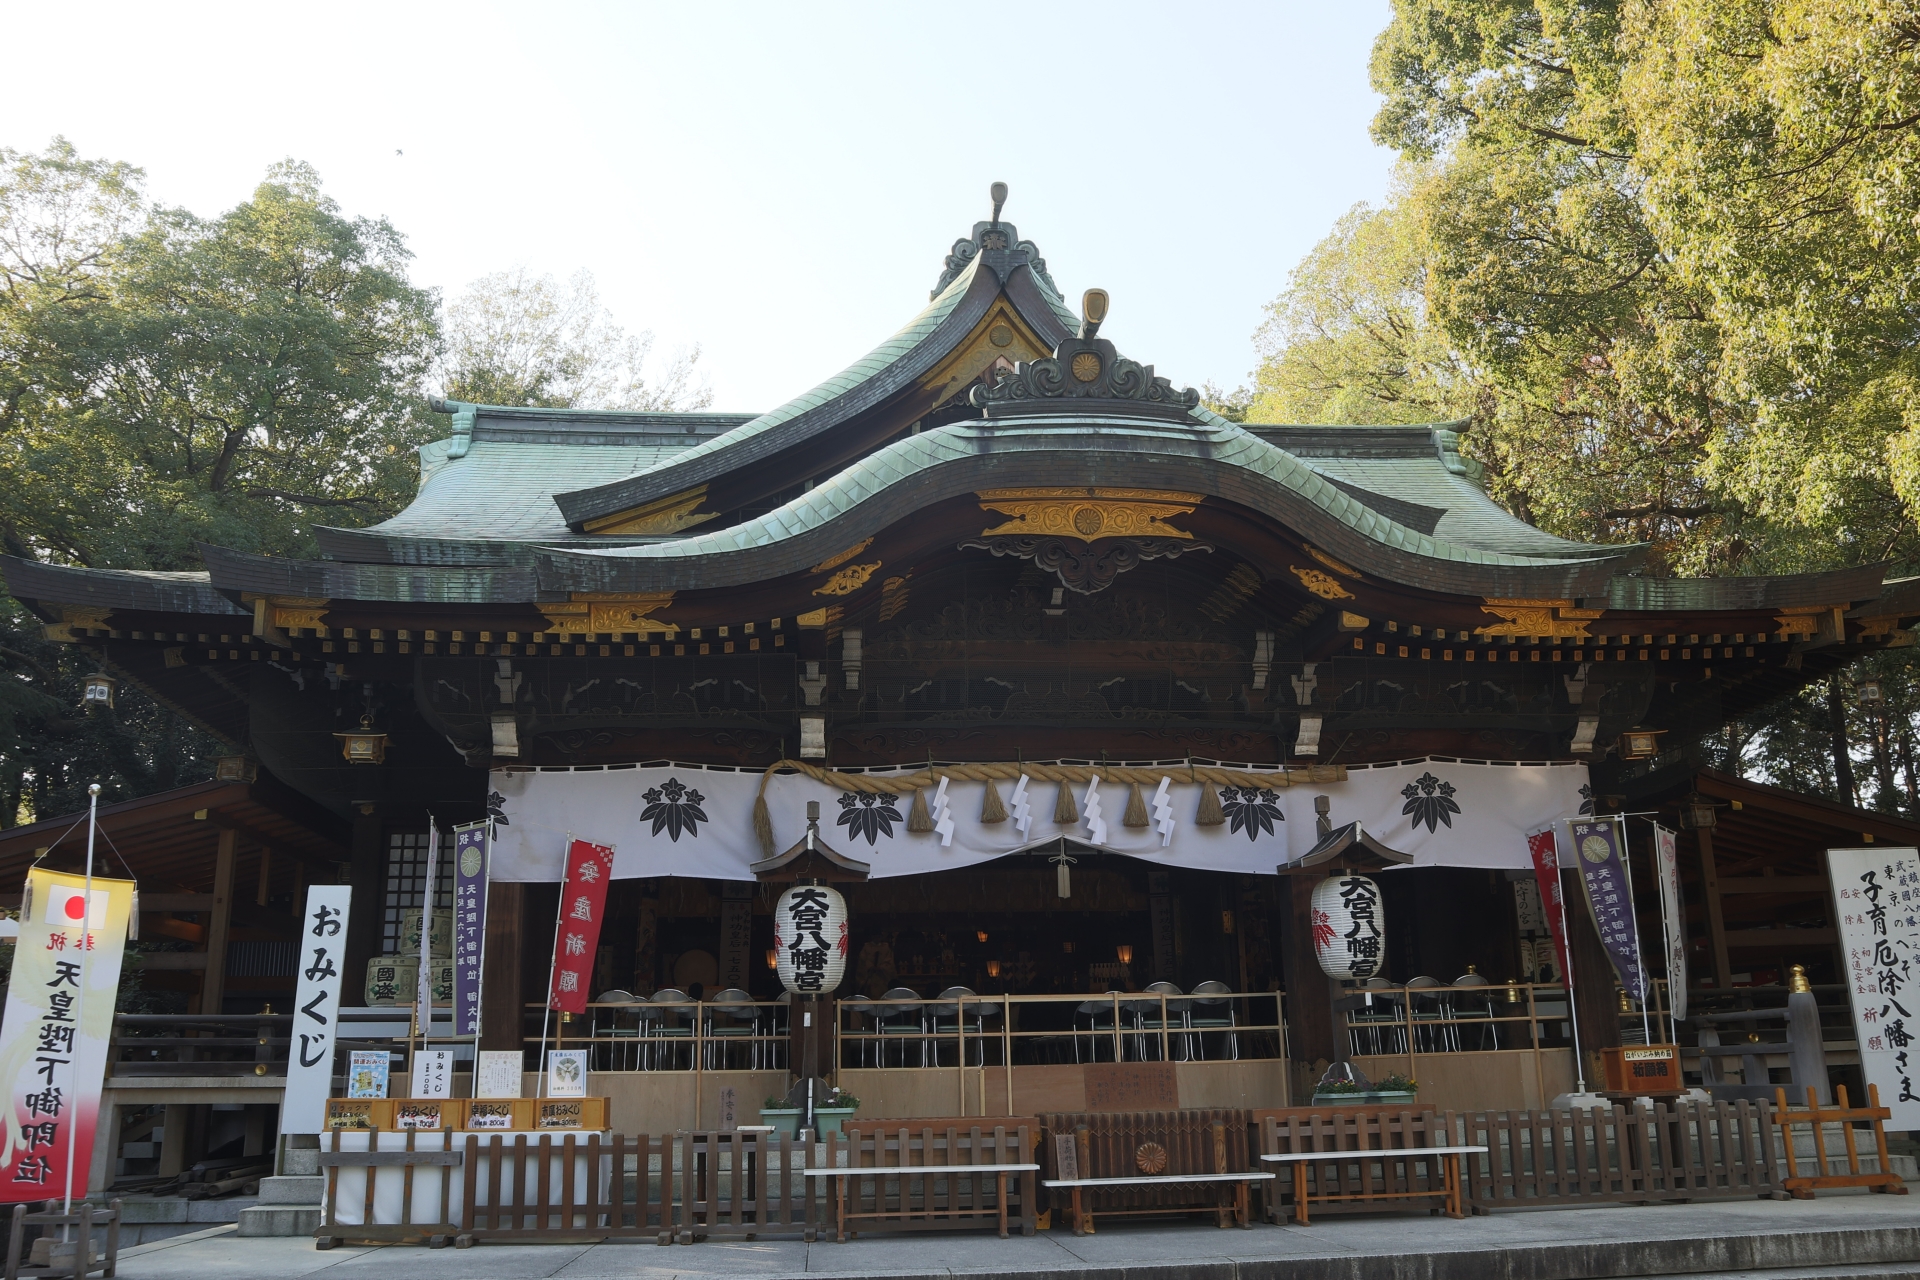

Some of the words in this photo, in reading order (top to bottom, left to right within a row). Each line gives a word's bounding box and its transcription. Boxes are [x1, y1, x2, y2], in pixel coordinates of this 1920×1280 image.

[788, 889, 831, 991] 大宮八幡宮
[1339, 877, 1381, 977] 大宮八幡宮
[1884, 865, 1911, 980] 東京のへそ
[299, 905, 341, 1068] おみくじ
[376, 967, 397, 1000] 國盛
[1860, 870, 1920, 1103] 子育厄除八幡さま
[1863, 1007, 1884, 1051] 祈願
[434, 1051, 445, 1092] おみくじ
[1632, 1061, 1668, 1077] 祈願箱
[401, 1105, 439, 1116] おみくじ
